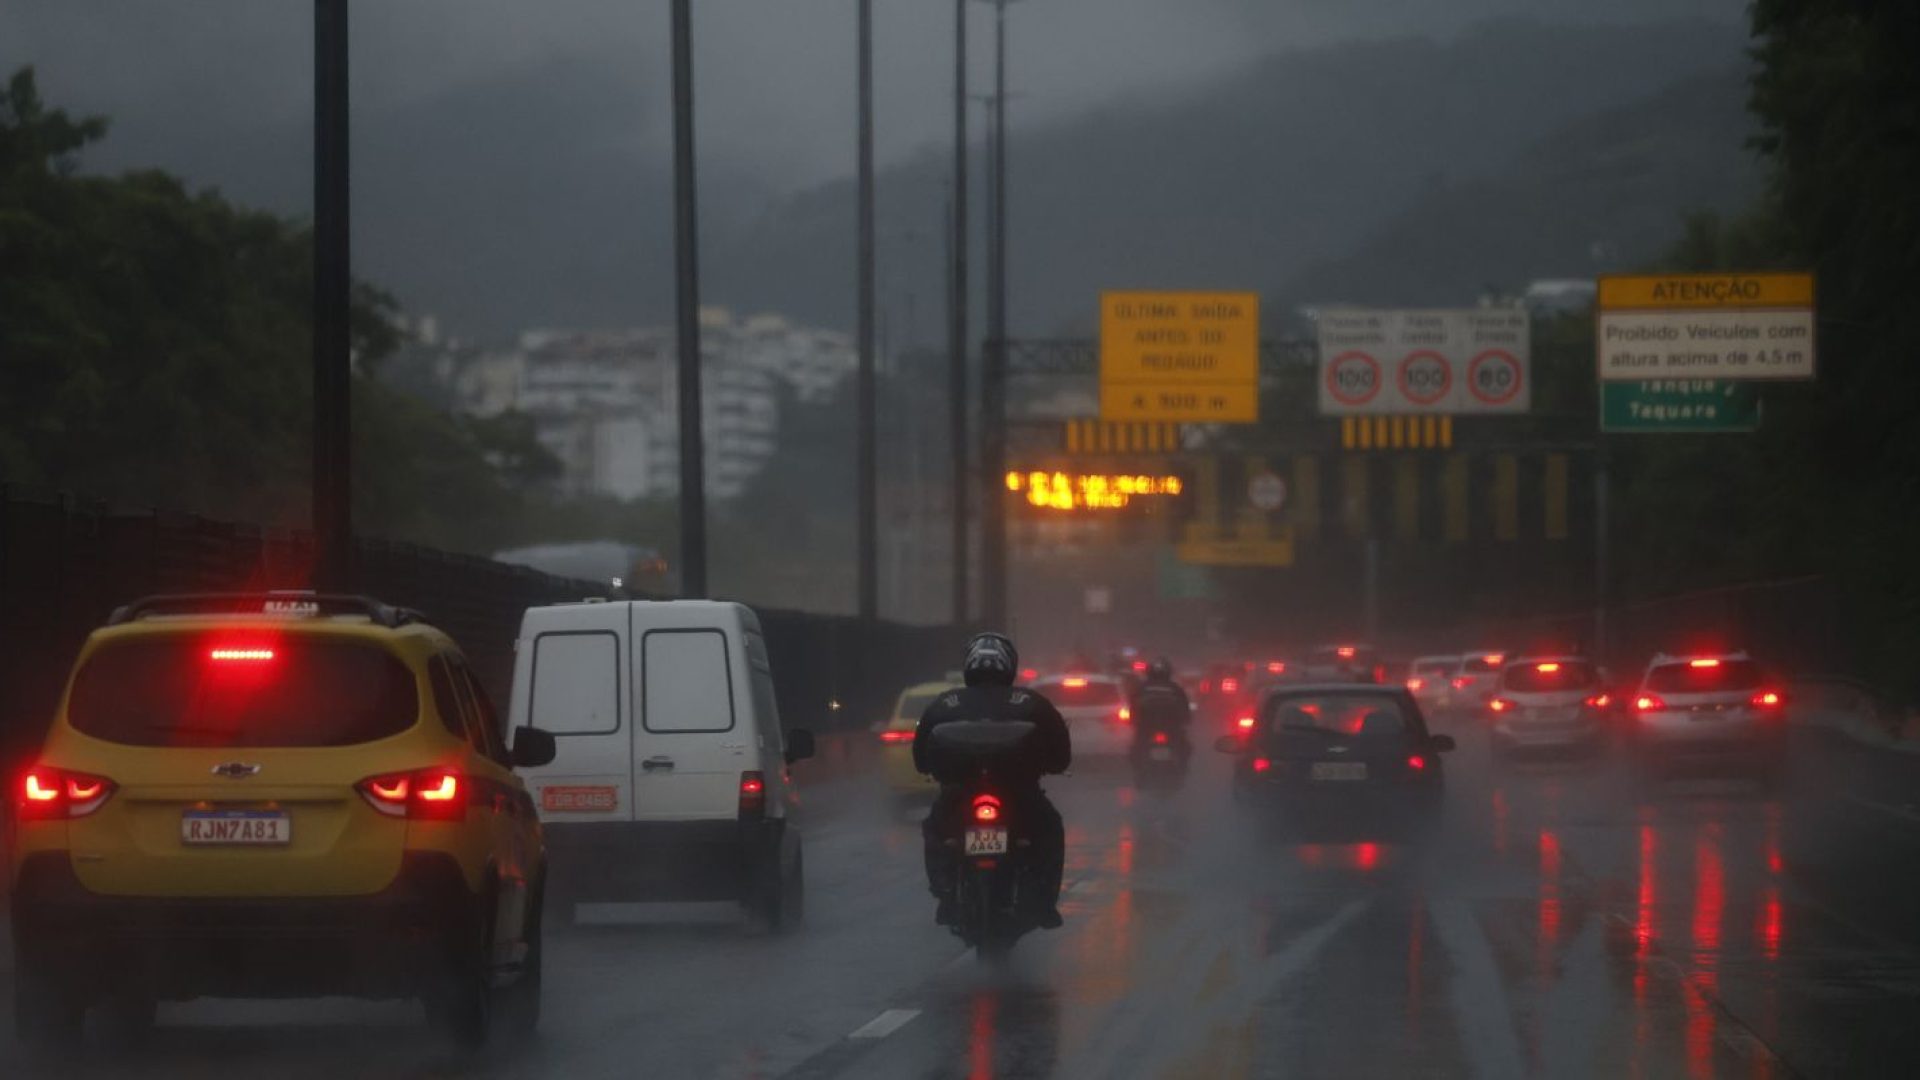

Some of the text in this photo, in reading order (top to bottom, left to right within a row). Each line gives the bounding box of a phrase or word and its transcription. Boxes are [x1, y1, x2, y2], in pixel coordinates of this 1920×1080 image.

[1652, 278, 1760, 302] ATENÇÃO
[1606, 323, 1679, 341] Proibido
[1767, 325, 1807, 339] com
[1610, 351, 1660, 367] altura
[1666, 351, 1719, 366] acima
[1726, 350, 1749, 365] de
[1338, 366, 1376, 387] 100
[1407, 366, 1446, 387] 100
[1629, 402, 1717, 421] Taquara
[191, 820, 278, 840] RJN7A81
